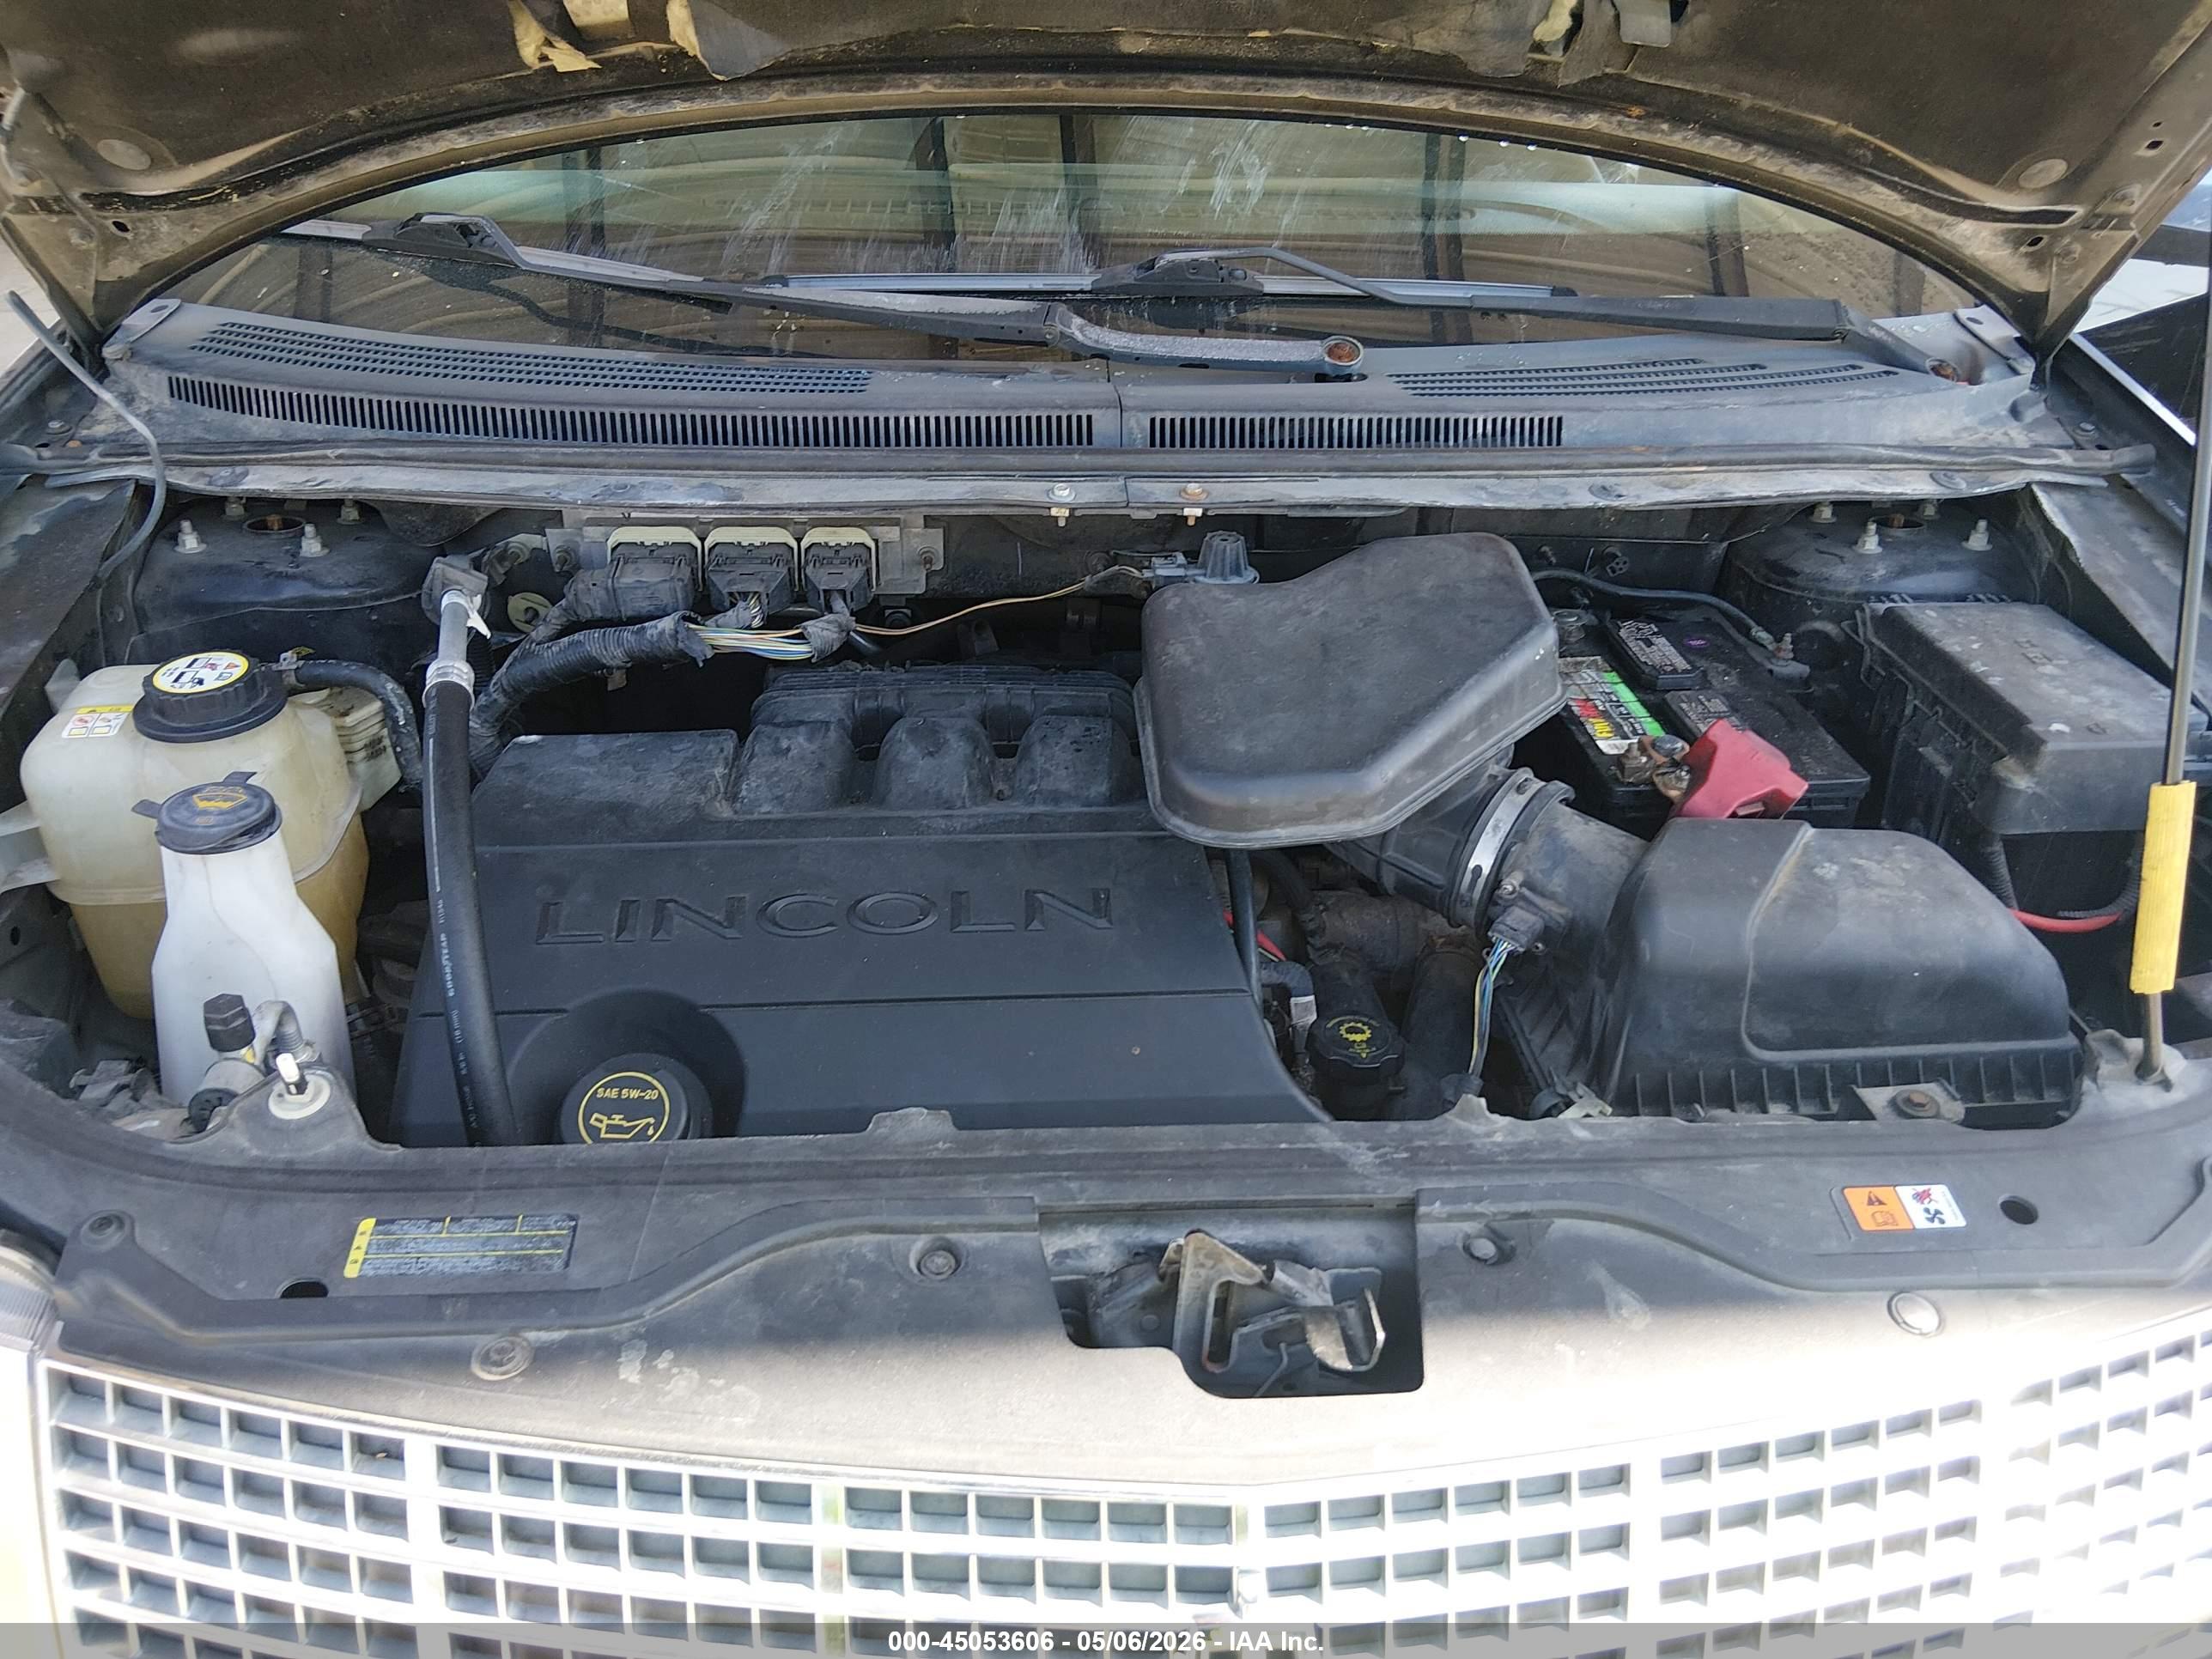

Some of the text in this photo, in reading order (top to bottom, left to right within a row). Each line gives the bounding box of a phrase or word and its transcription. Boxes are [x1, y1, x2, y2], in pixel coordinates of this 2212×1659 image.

[536, 887, 1114, 944] LINCOLN
[596, 1088, 659, 1100] SAE 5W-20
